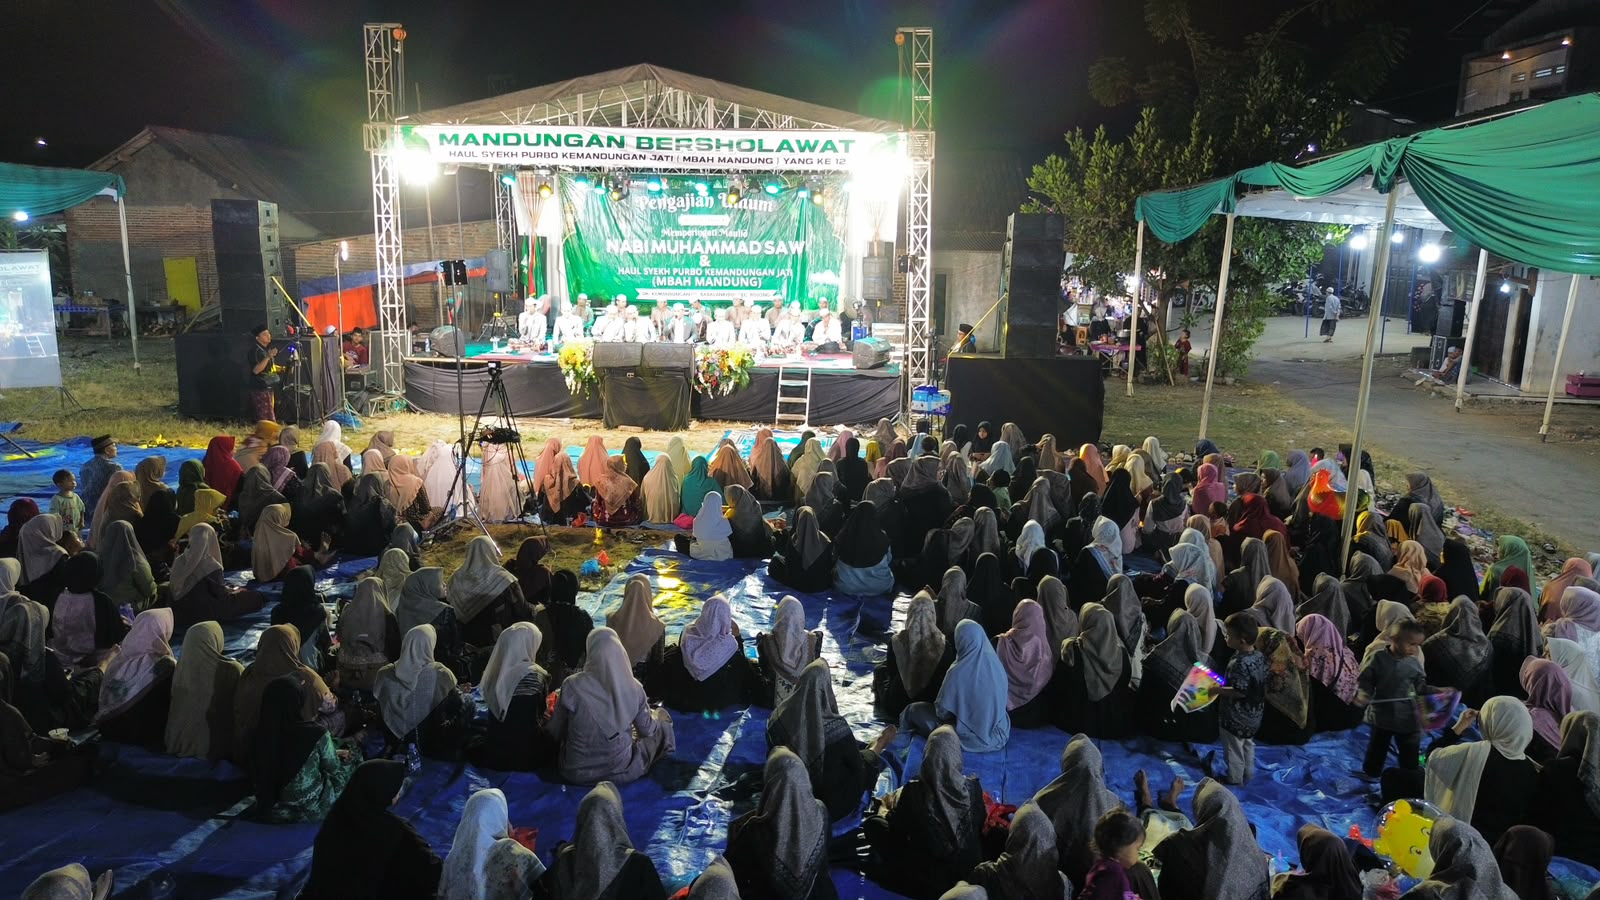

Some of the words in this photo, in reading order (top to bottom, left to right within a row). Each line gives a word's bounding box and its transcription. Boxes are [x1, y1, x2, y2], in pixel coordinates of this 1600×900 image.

[439, 133, 625, 149] MANDUNGAN
[636, 136, 856, 153] BERSHOLAWAT
[522, 151, 558, 159] PURBO
[562, 152, 646, 160] KEMANDUNGAN
[635, 193, 714, 212] Pengajian
[718, 228, 749, 238] Maulid
[606, 240, 648, 254] NABI
[652, 240, 762, 254] MUHAMMAD
[764, 240, 806, 255] SAW
[700, 255, 711, 266] &
[672, 268, 702, 276] PURBO
[704, 268, 775, 277] KEMANDUNGAN
[776, 268, 793, 278] JATI
[652, 277, 691, 288] (MBAH
[694, 277, 762, 288] MANDUNG)
